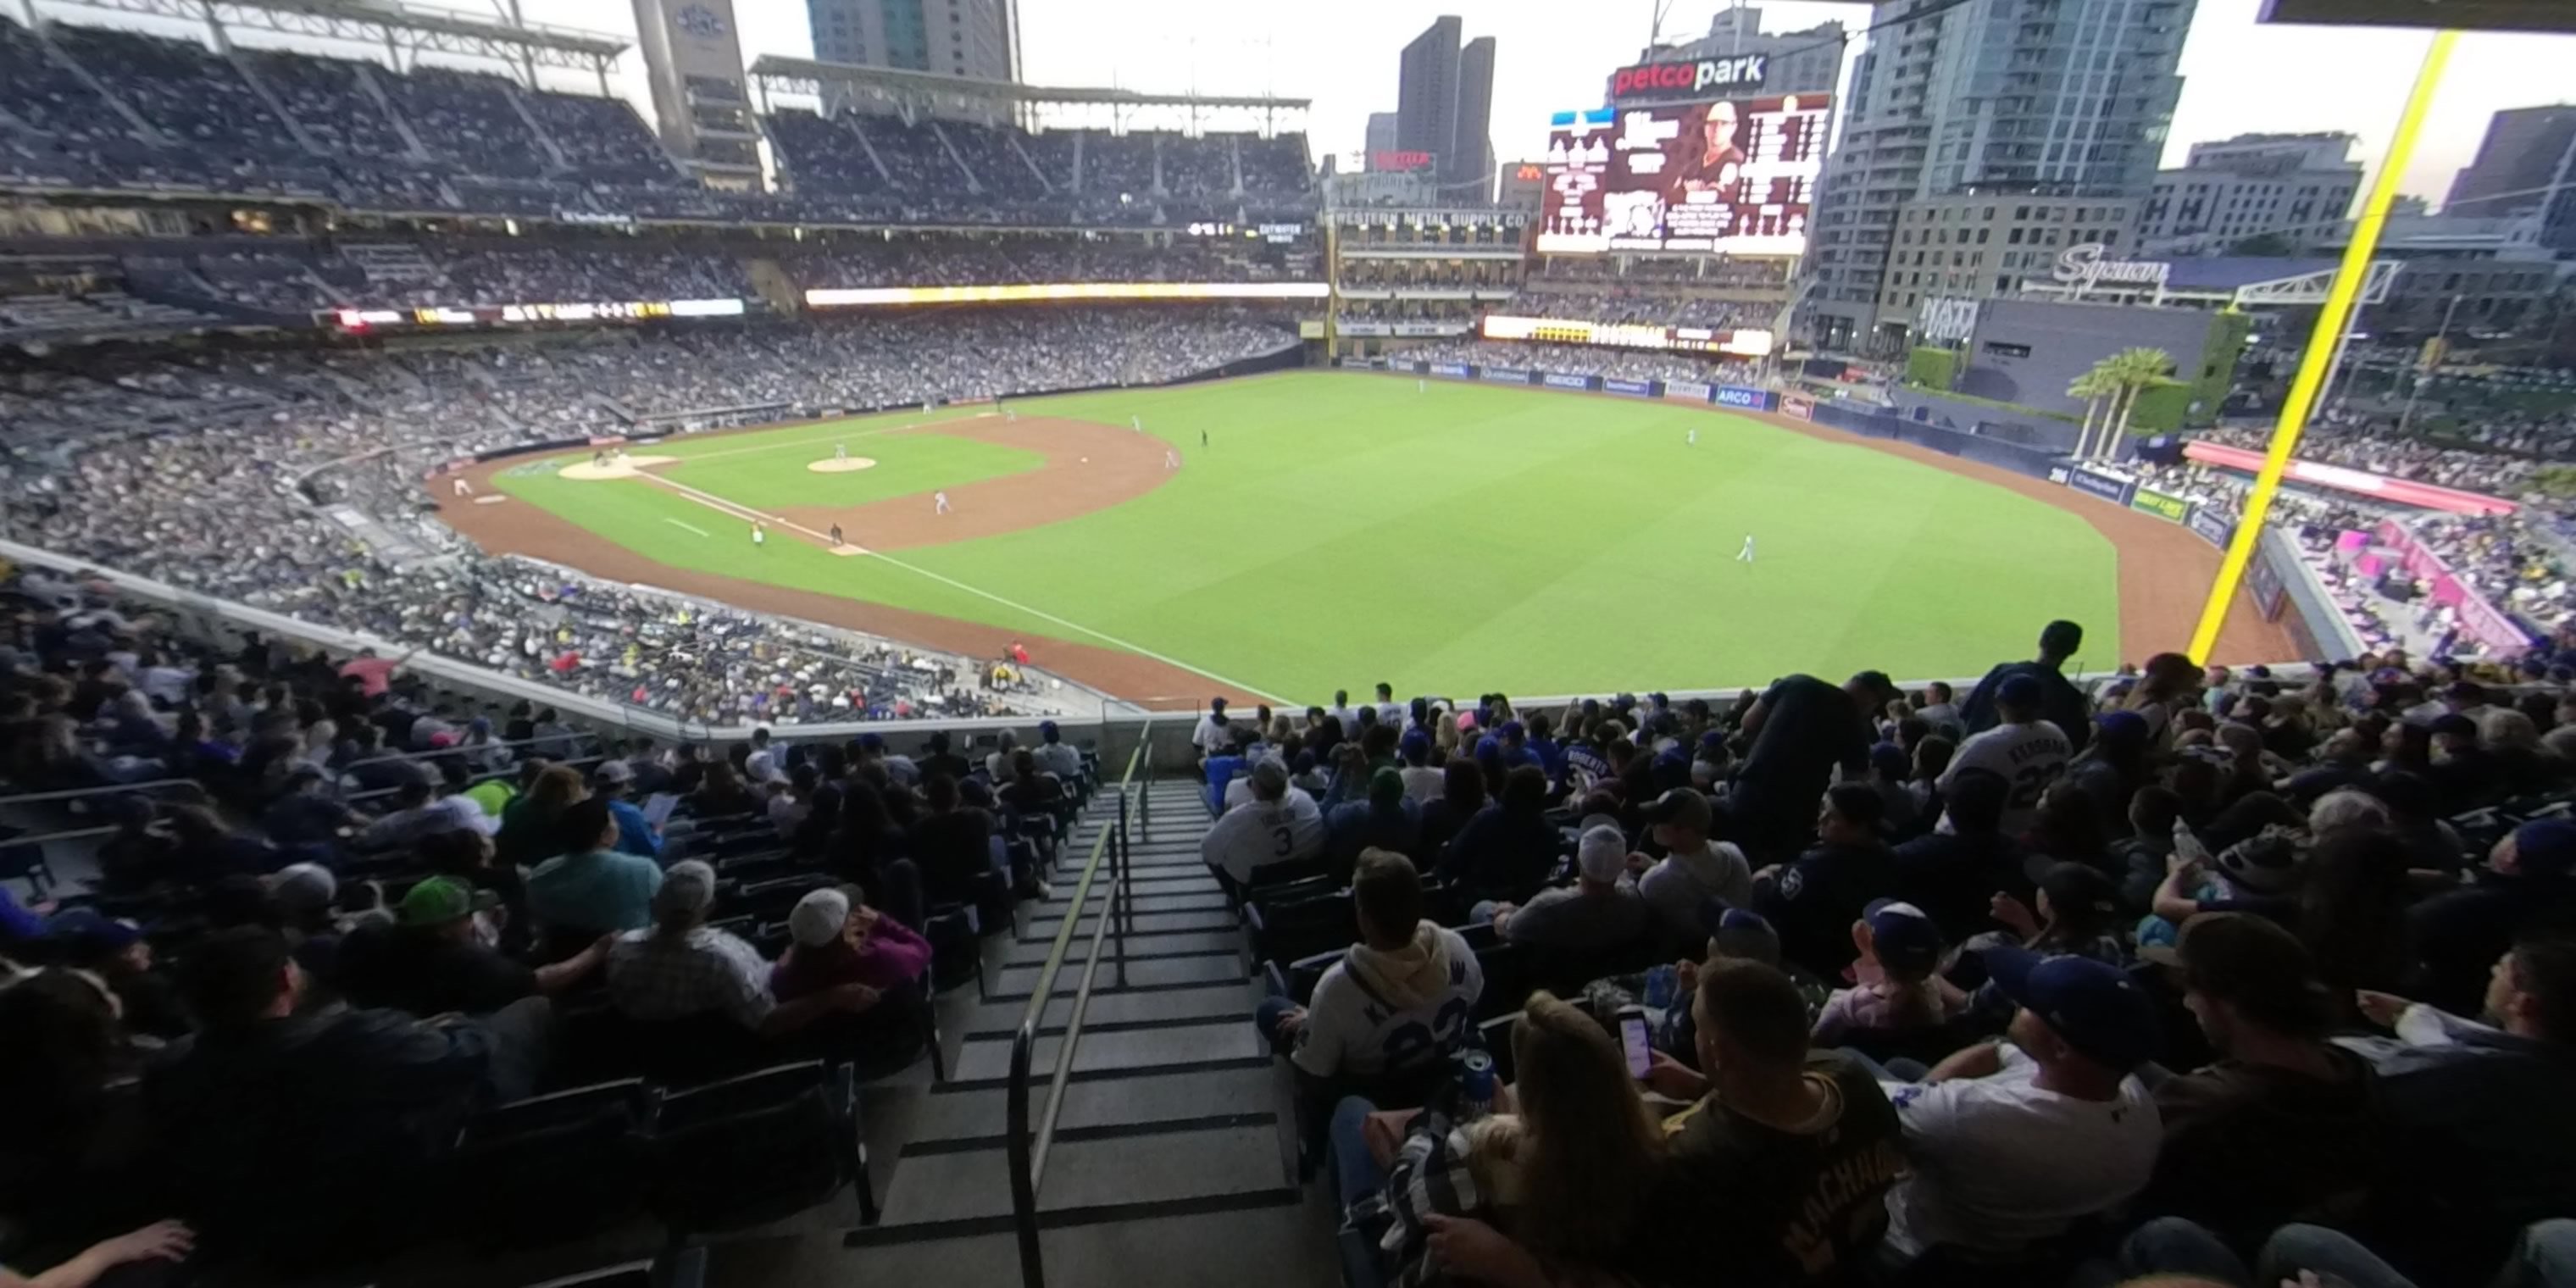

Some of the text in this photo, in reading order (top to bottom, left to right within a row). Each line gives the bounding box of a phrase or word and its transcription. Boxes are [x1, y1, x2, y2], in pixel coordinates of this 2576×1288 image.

[1614, 54, 1765, 95] petco park
[1336, 213, 1524, 227] WESTERN METAL SUPPLY CO
[2053, 243, 2170, 291] Sycuan
[1546, 375, 1585, 387] GEICO
[1718, 390, 1752, 405] ARCO
[1568, 749, 1608, 776] ROBERTS
[1273, 826, 1293, 856] 3
